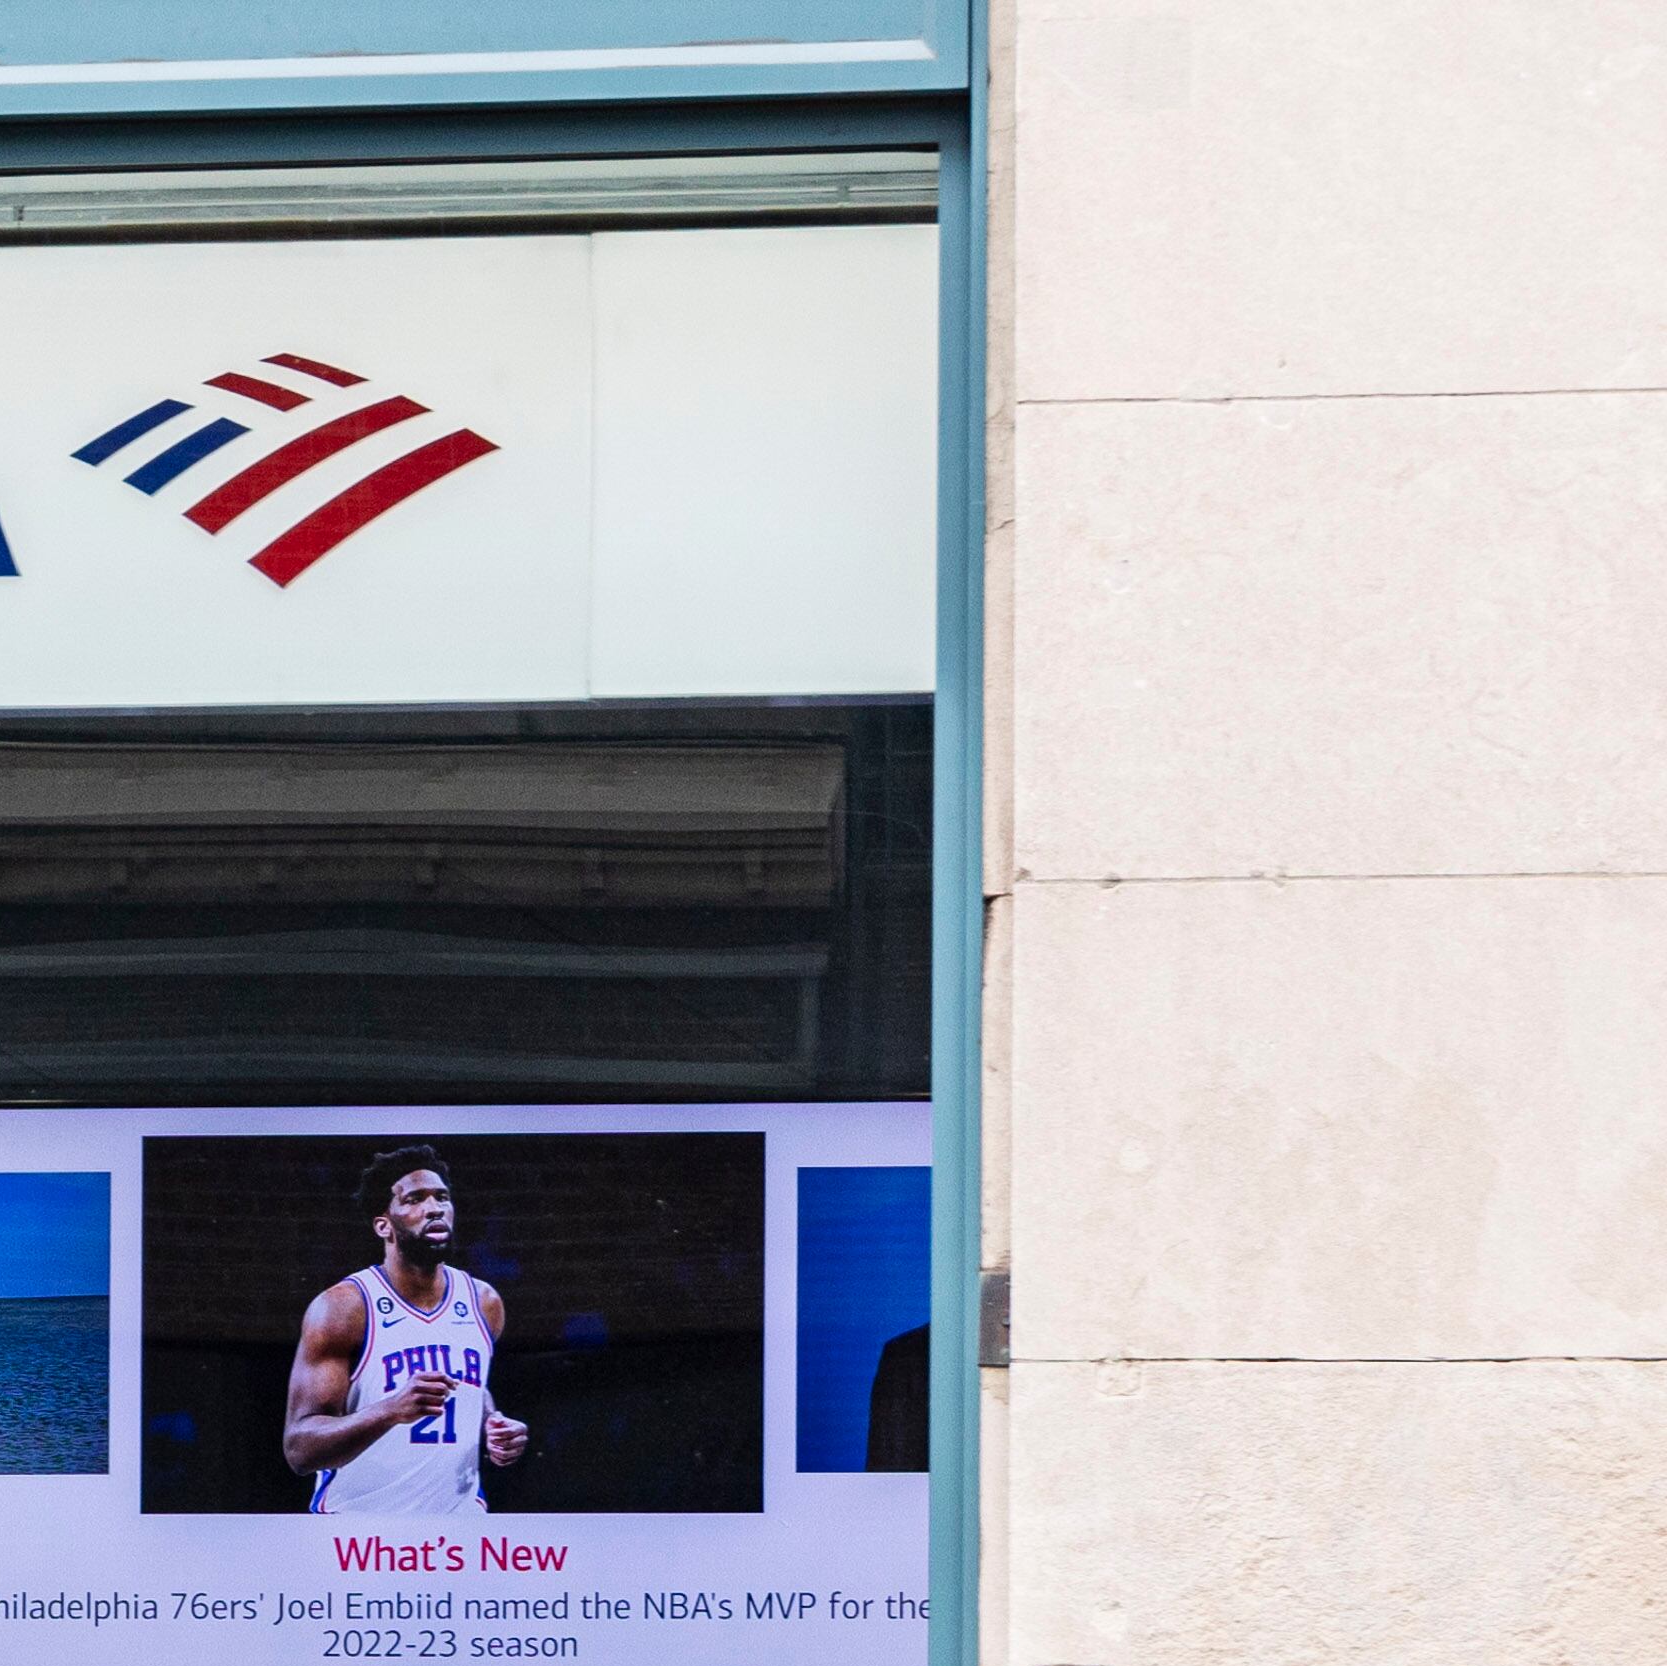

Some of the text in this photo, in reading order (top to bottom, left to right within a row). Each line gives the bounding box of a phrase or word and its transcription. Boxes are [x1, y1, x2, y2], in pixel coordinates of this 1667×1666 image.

[382, 1344, 482, 1393] PHILA
[409, 1397, 457, 1444] 21
[333, 1535, 569, 1572] What's New
[170, 1591, 265, 1621] 76ers'
[272, 1591, 333, 1626] Joel
[346, 1591, 453, 1621] Embiid
[464, 1591, 570, 1621] named
[580, 1591, 632, 1621] the
[643, 1591, 734, 1621] NBA's
[746, 1591, 818, 1621] MVP
[828, 1590, 875, 1621] for
[884, 1591, 931, 1621] the
[322, 1629, 579, 1659] 2022-23 season
